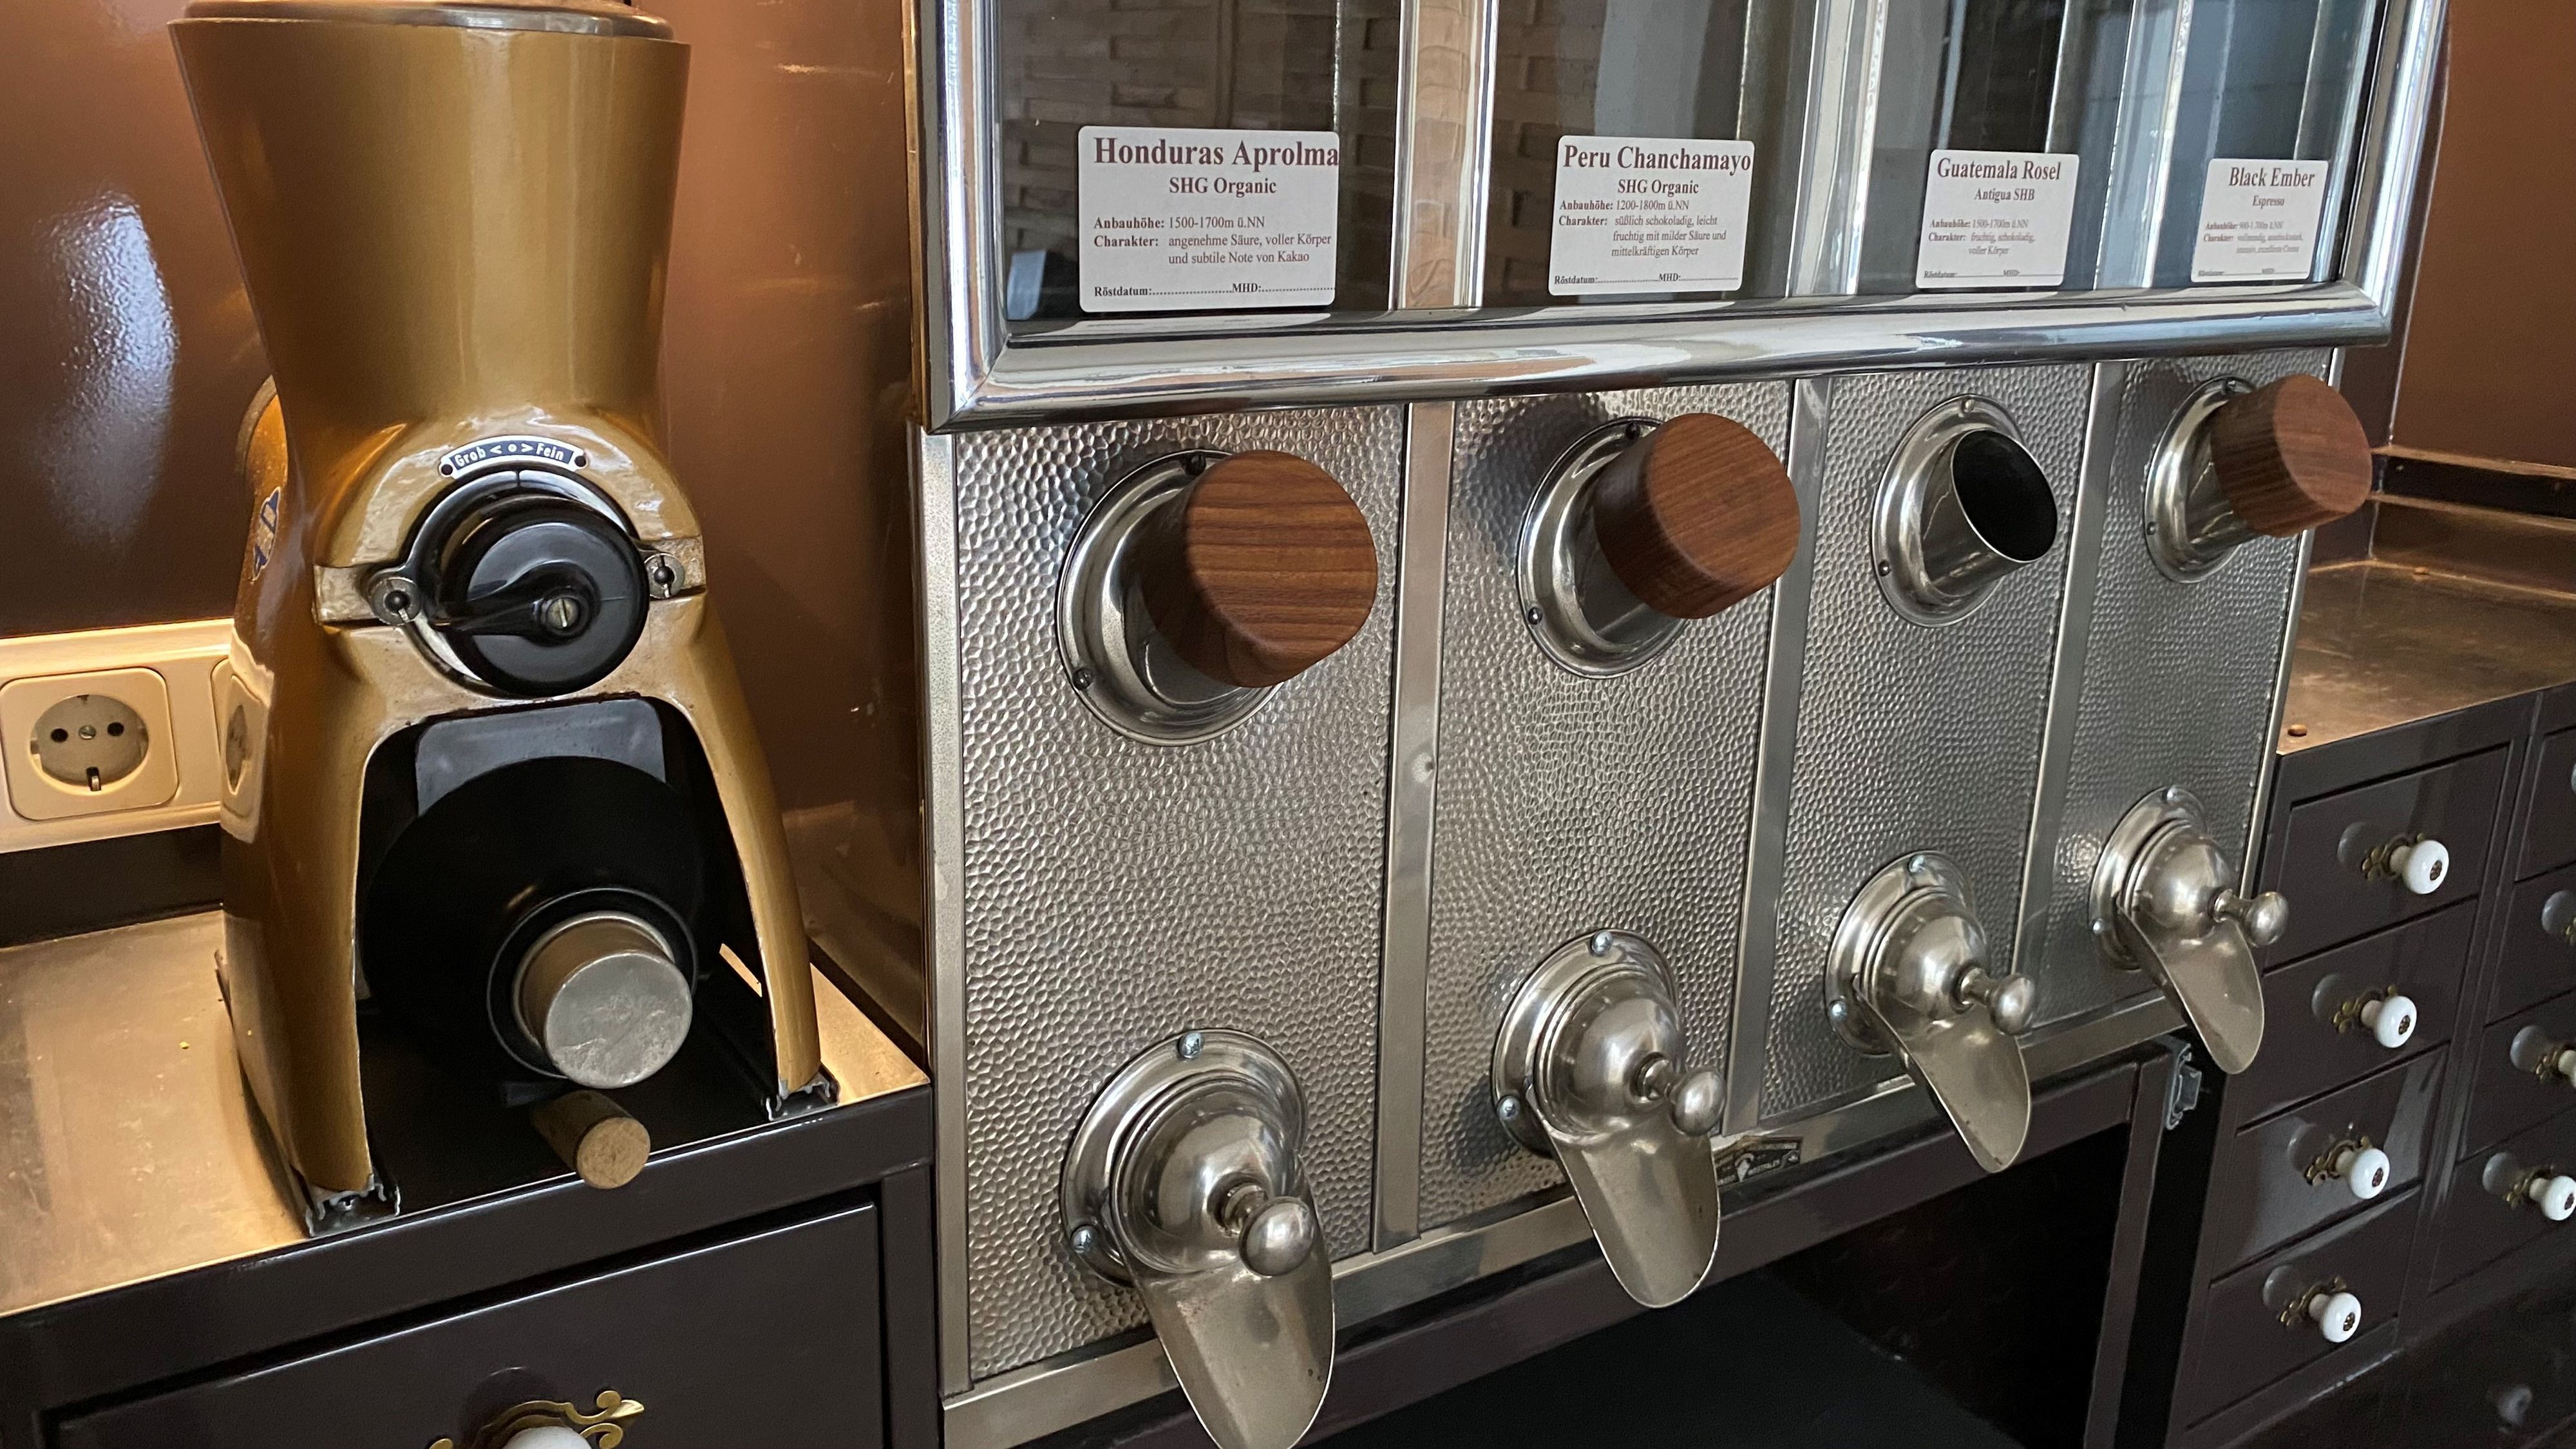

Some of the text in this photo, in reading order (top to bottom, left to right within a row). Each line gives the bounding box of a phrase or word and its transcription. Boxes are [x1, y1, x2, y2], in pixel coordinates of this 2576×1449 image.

[1094, 137, 1339, 172] Honduras Aprolma
[1563, 145, 1751, 176] Peru Chanchamayo
[1938, 158, 2061, 180] Guatemala Rosel
[2229, 167, 2315, 187] Black Ember
[1169, 178, 1276, 198] SHG Organic
[1618, 179, 1699, 197] SHG Organic
[1974, 188, 2035, 203] Antigua SHB
[1560, 200, 1613, 210] Anbauhöhe:
[1616, 200, 1665, 210] 1200-1800m
[2253, 195, 2284, 209] Espresso
[1094, 216, 1265, 229] Anbauhöhe: 1500-1700m ü.NN
[1559, 215, 1718, 228] Charakter: süßlich schokoladig, leicht
[1094, 234, 1332, 250] Charakter: angenehme Säure, voller Körper
[1613, 230, 1726, 243] fruchtig mit milder Säure und
[1169, 251, 1309, 264] und subtile Note von Kakao
[1612, 246, 1699, 258] mittelkräftigen Körper
[454, 442, 564, 467] Grob Fein
